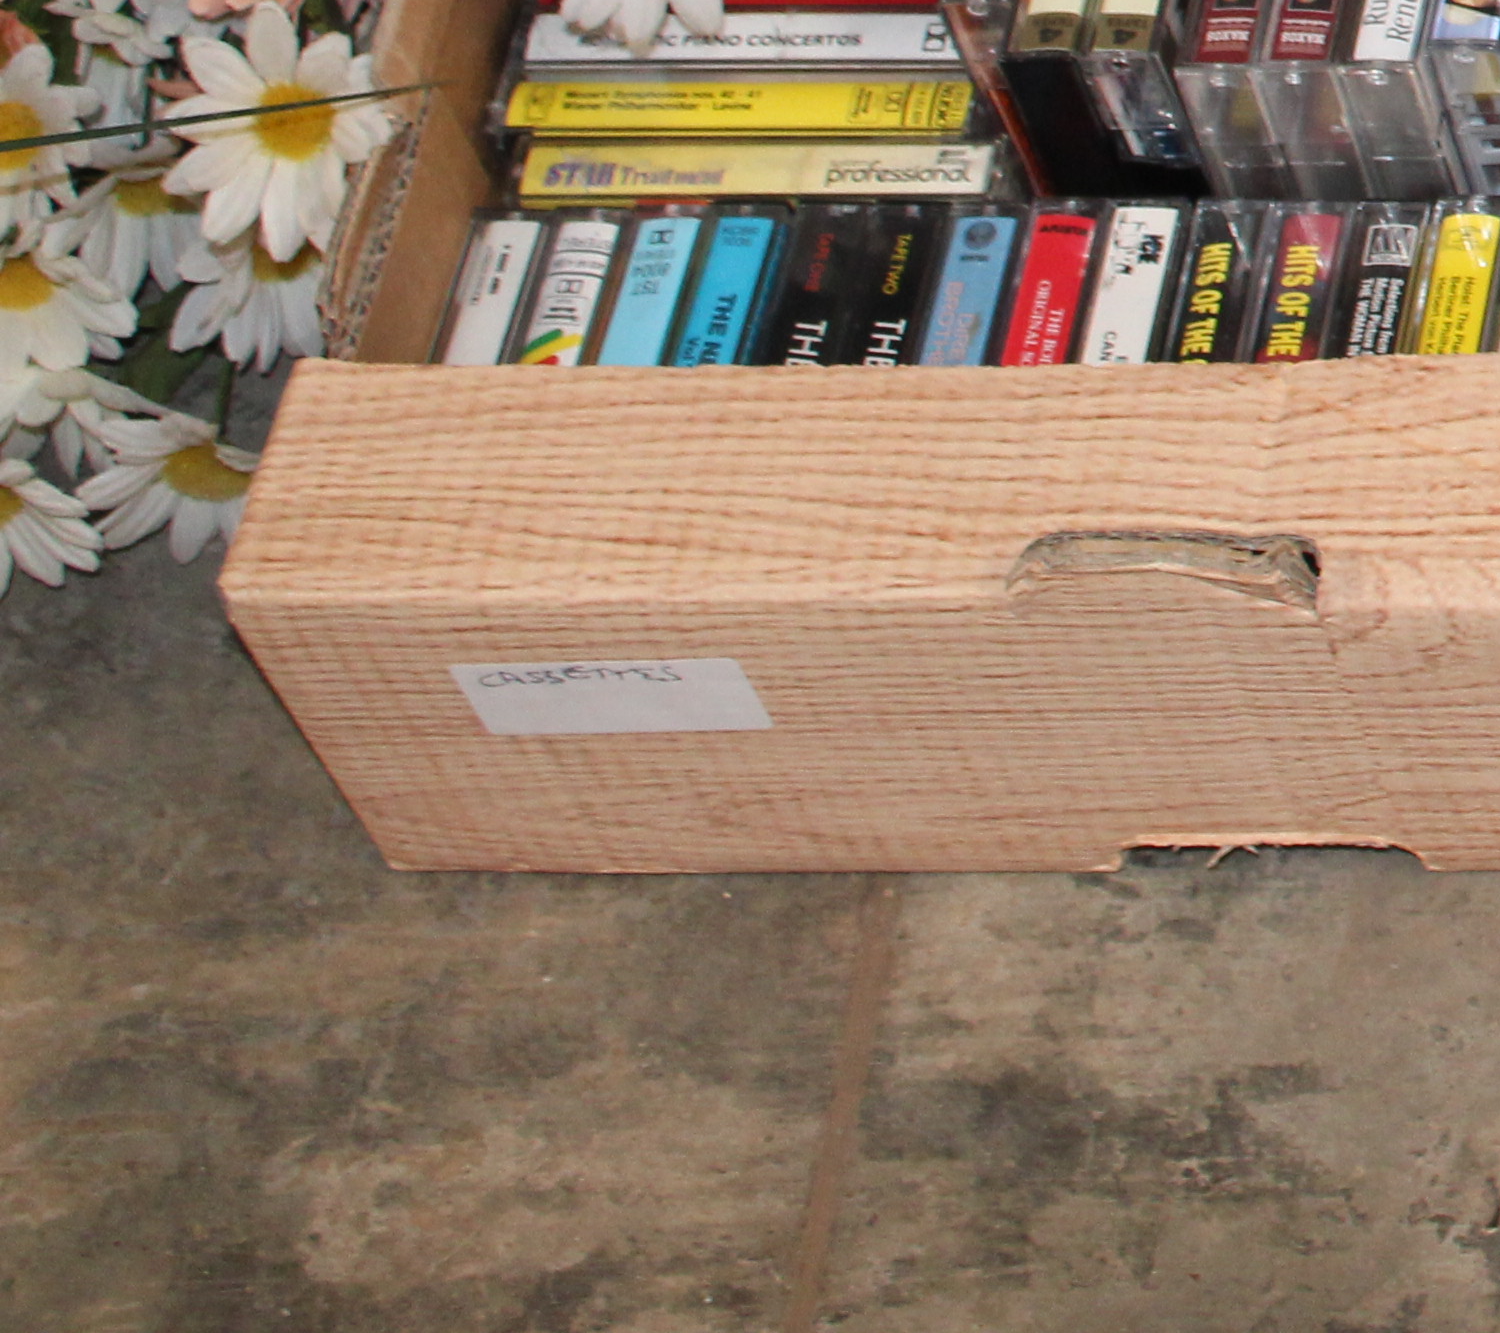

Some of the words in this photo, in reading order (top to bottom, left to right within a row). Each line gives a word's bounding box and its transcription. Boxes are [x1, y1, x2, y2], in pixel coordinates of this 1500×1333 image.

[680, 34, 742, 47] PIANO
[745, 34, 863, 48] CONCERTOS
[824, 161, 971, 187] professional
[1195, 242, 1232, 286] HITS
[1281, 244, 1319, 288] HITS
[706, 293, 738, 336] THE
[1029, 279, 1052, 347] ORIGINAL
[1188, 289, 1223, 317] OF
[1275, 290, 1310, 318] OF
[1098, 331, 1117, 363] CAN
[1180, 319, 1215, 357] THE
[1266, 320, 1305, 357] THE
